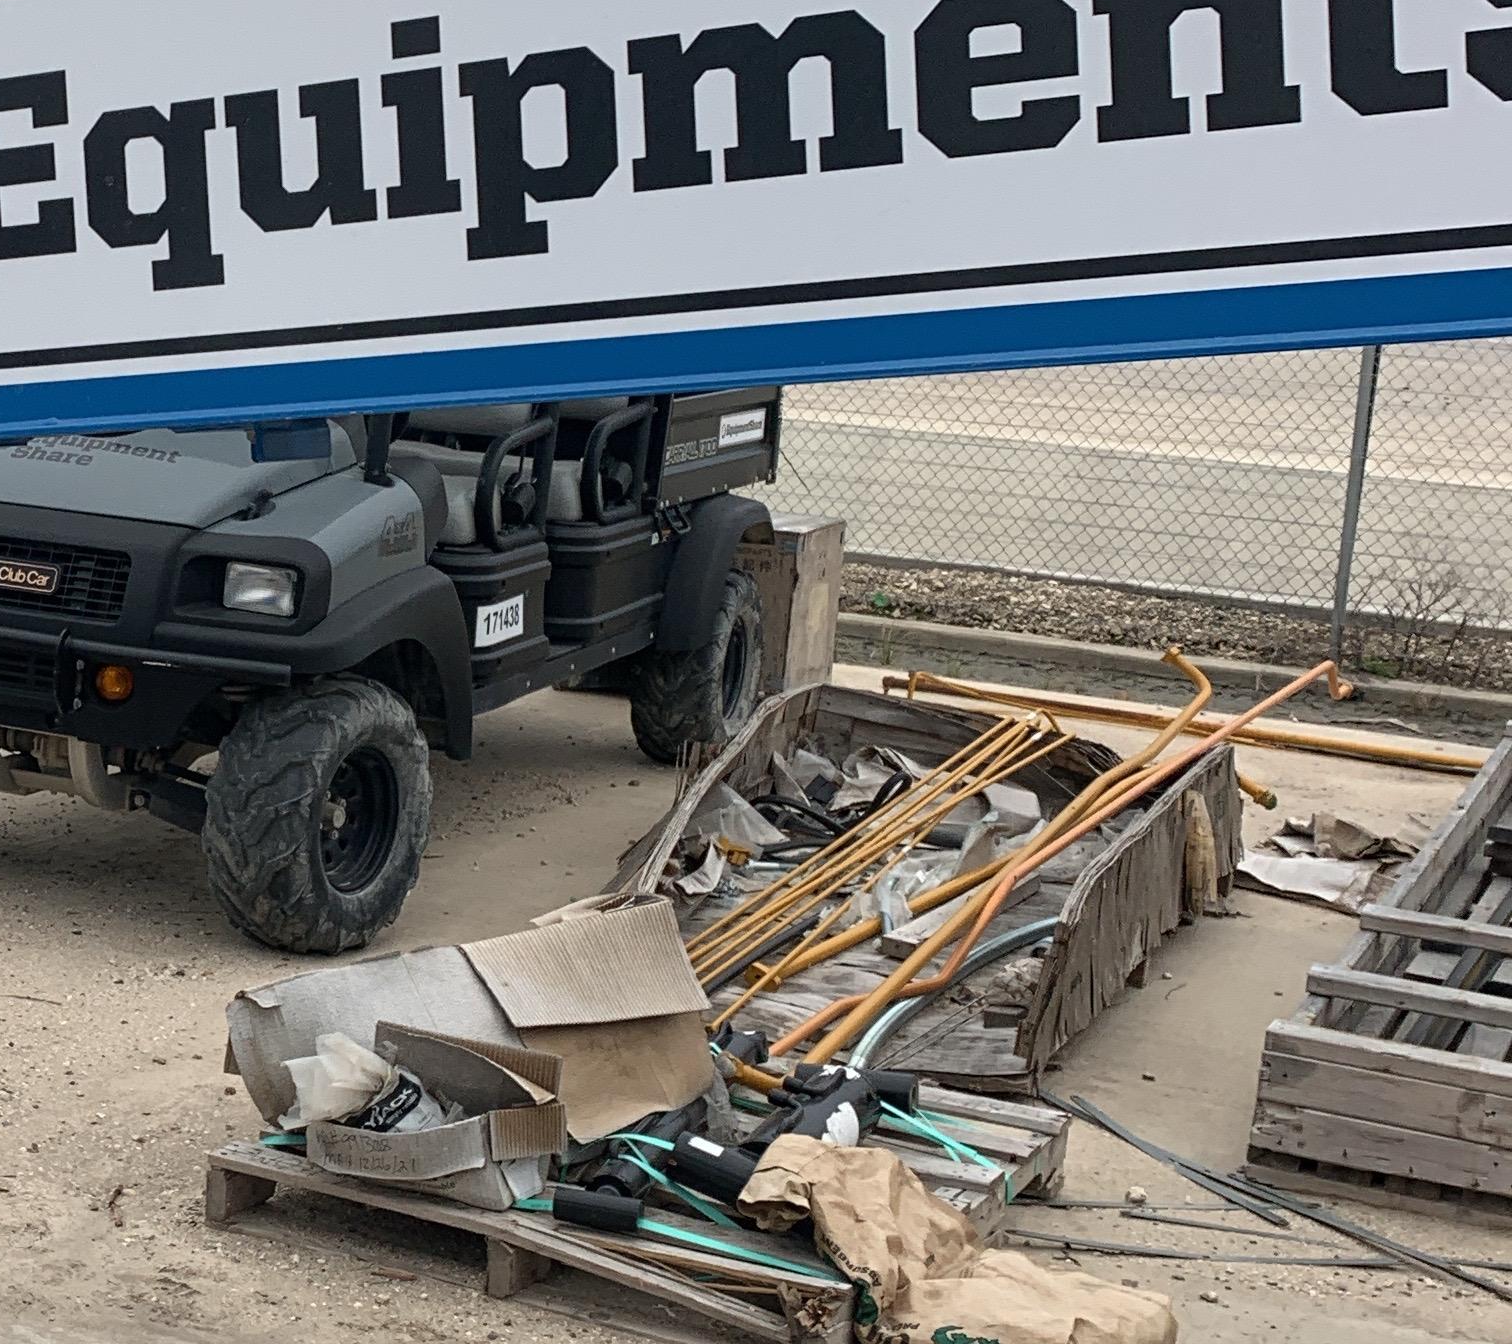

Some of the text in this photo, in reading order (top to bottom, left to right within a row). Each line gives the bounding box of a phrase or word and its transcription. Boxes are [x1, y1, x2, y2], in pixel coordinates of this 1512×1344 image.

[10, 445, 94, 466] Share
[27, 570, 50, 587] Car
[483, 603, 520, 636] 171438
